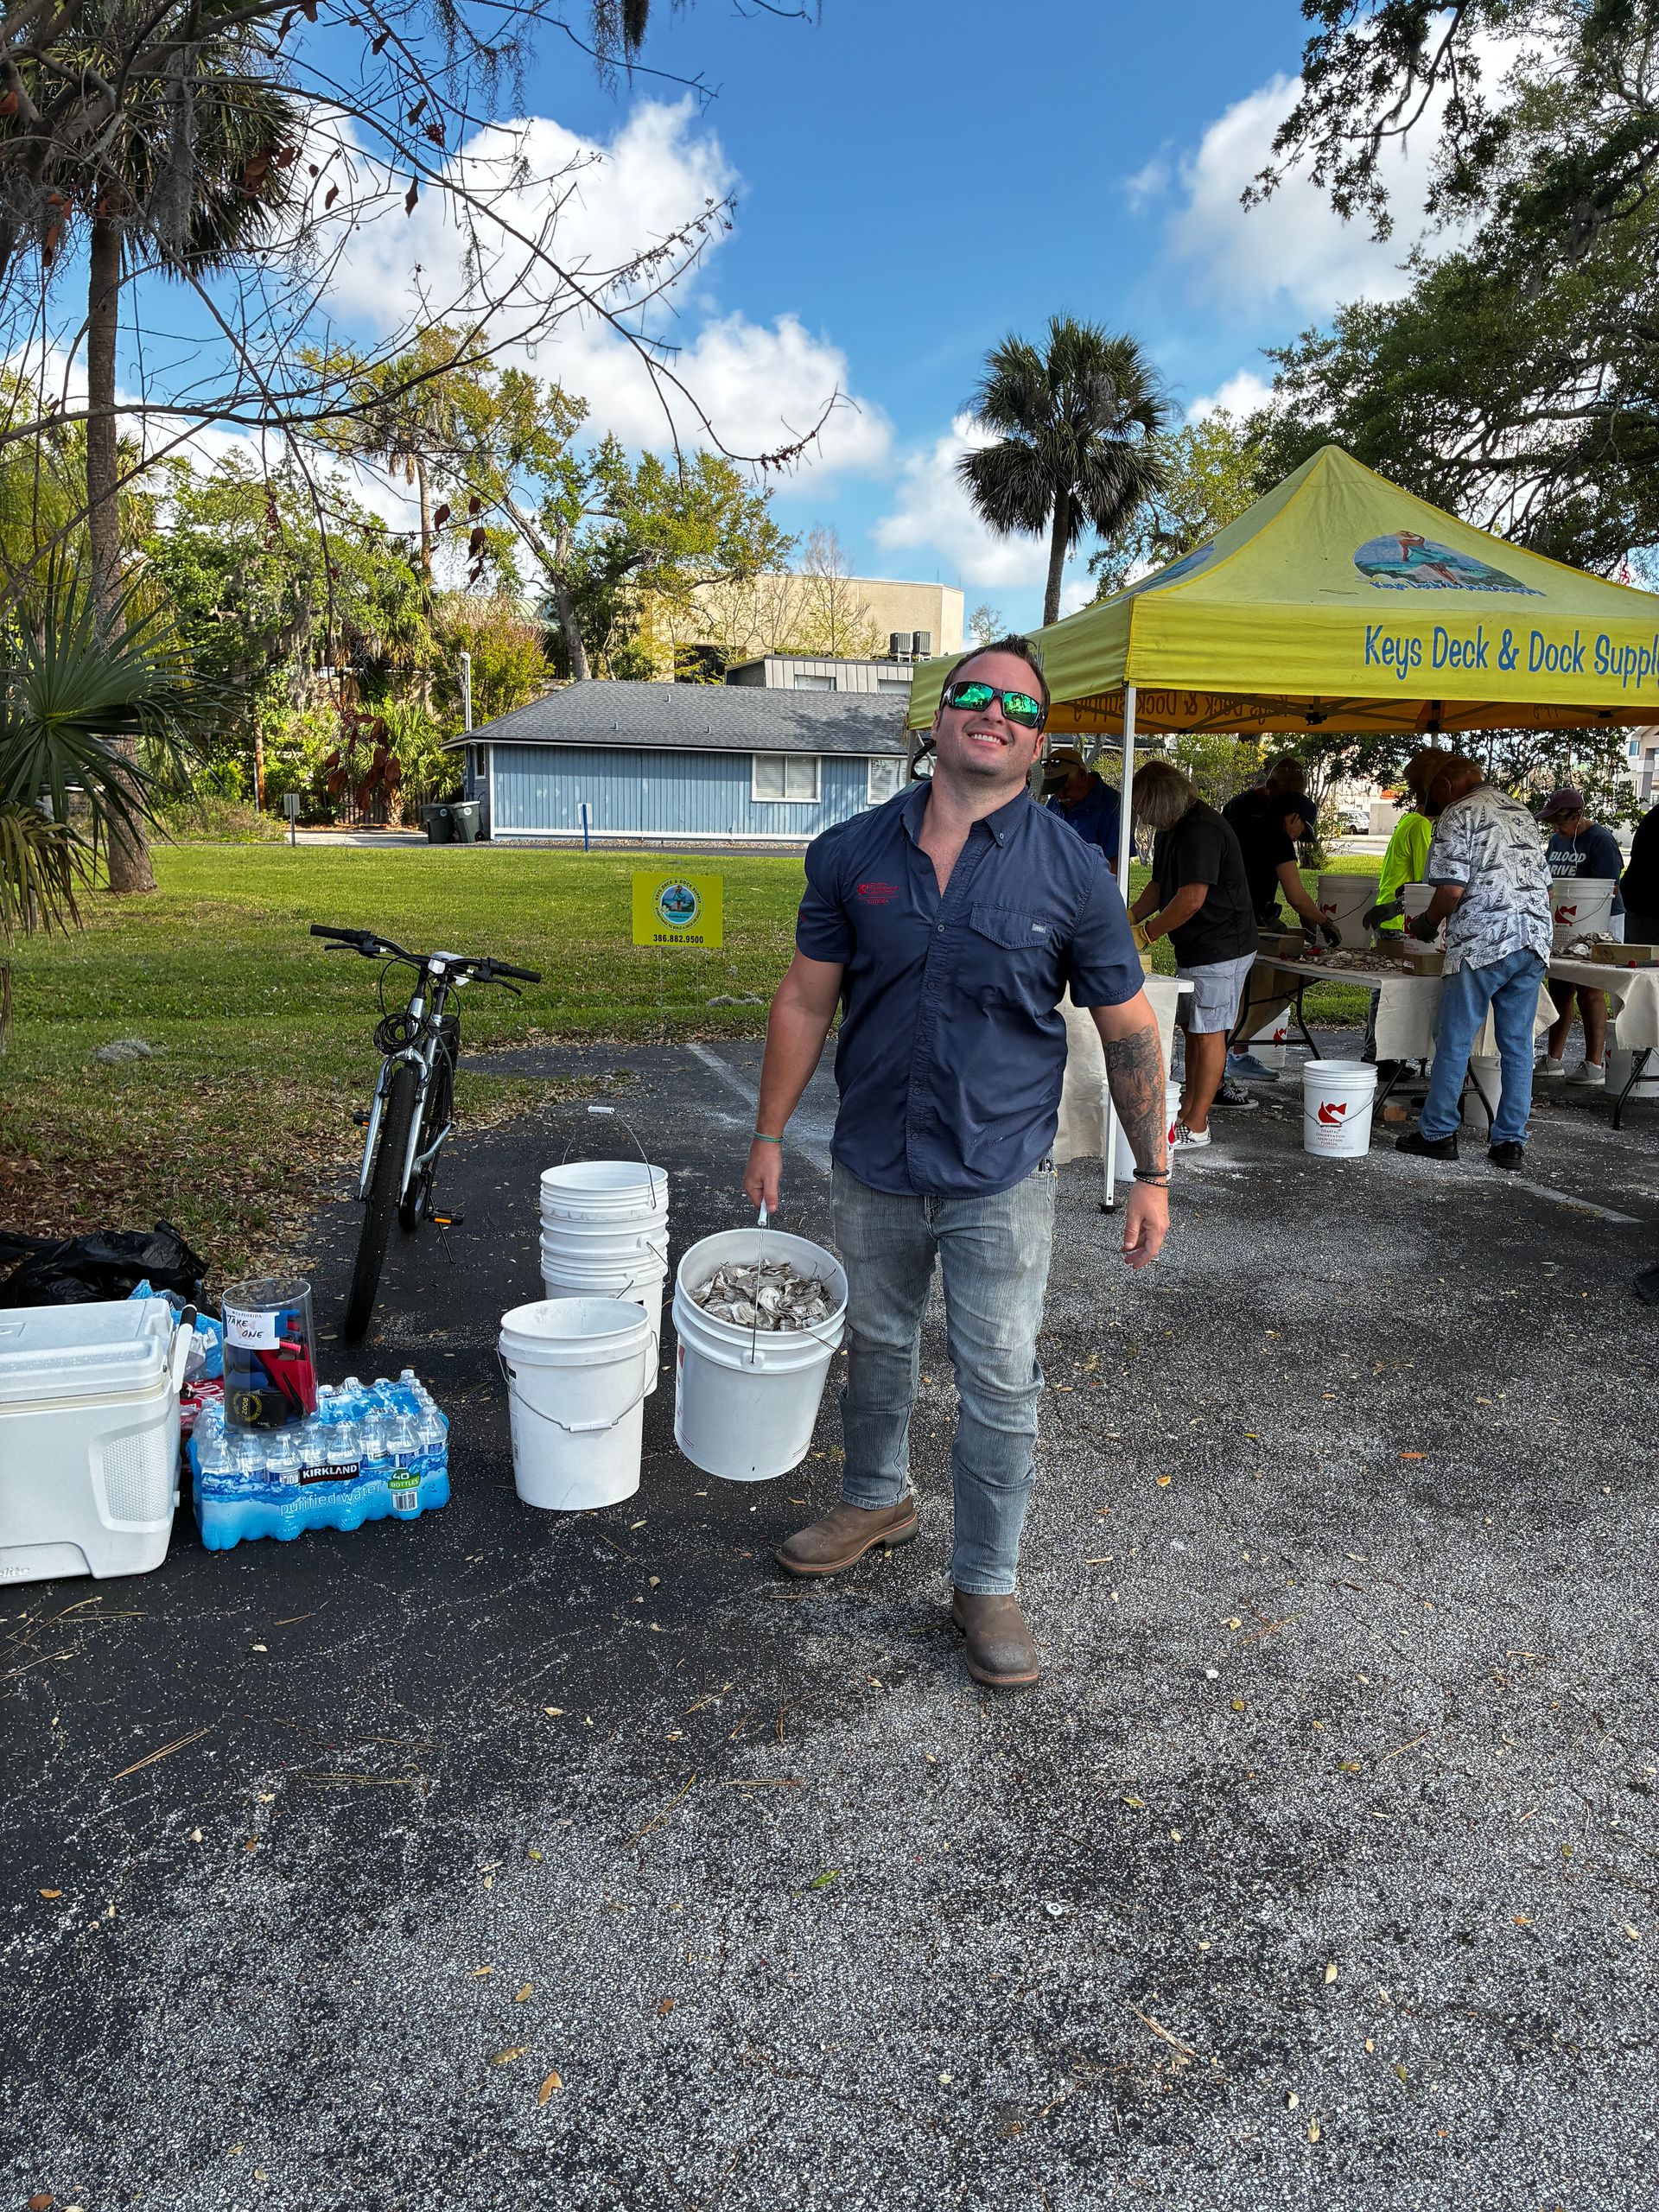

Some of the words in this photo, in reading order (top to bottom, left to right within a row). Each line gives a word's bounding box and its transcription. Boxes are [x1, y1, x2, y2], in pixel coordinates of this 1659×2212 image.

[1365, 625, 1422, 681] Keys
[1432, 626, 1490, 669] Deck
[1497, 628, 1519, 671] &
[1529, 630, 1586, 673] Dock
[1594, 633, 1659, 689] Suppl
[1548, 851, 1586, 863] BLOOD
[1549, 864, 1577, 876] RIVE
[662, 880, 673, 890] DECK
[679, 879, 693, 887] DOCK
[692, 887, 702, 904] SUPPLY
[653, 934, 703, 944] 386.882.9500
[227, 1314, 248, 1328] TAKE
[242, 1330, 264, 1338] ONE
[302, 1465, 358, 1479] KIRKLAND
[391, 1478, 420, 1488] BOTTLES
[279, 1492, 337, 1516] purified
[341, 1483, 383, 1503] water
